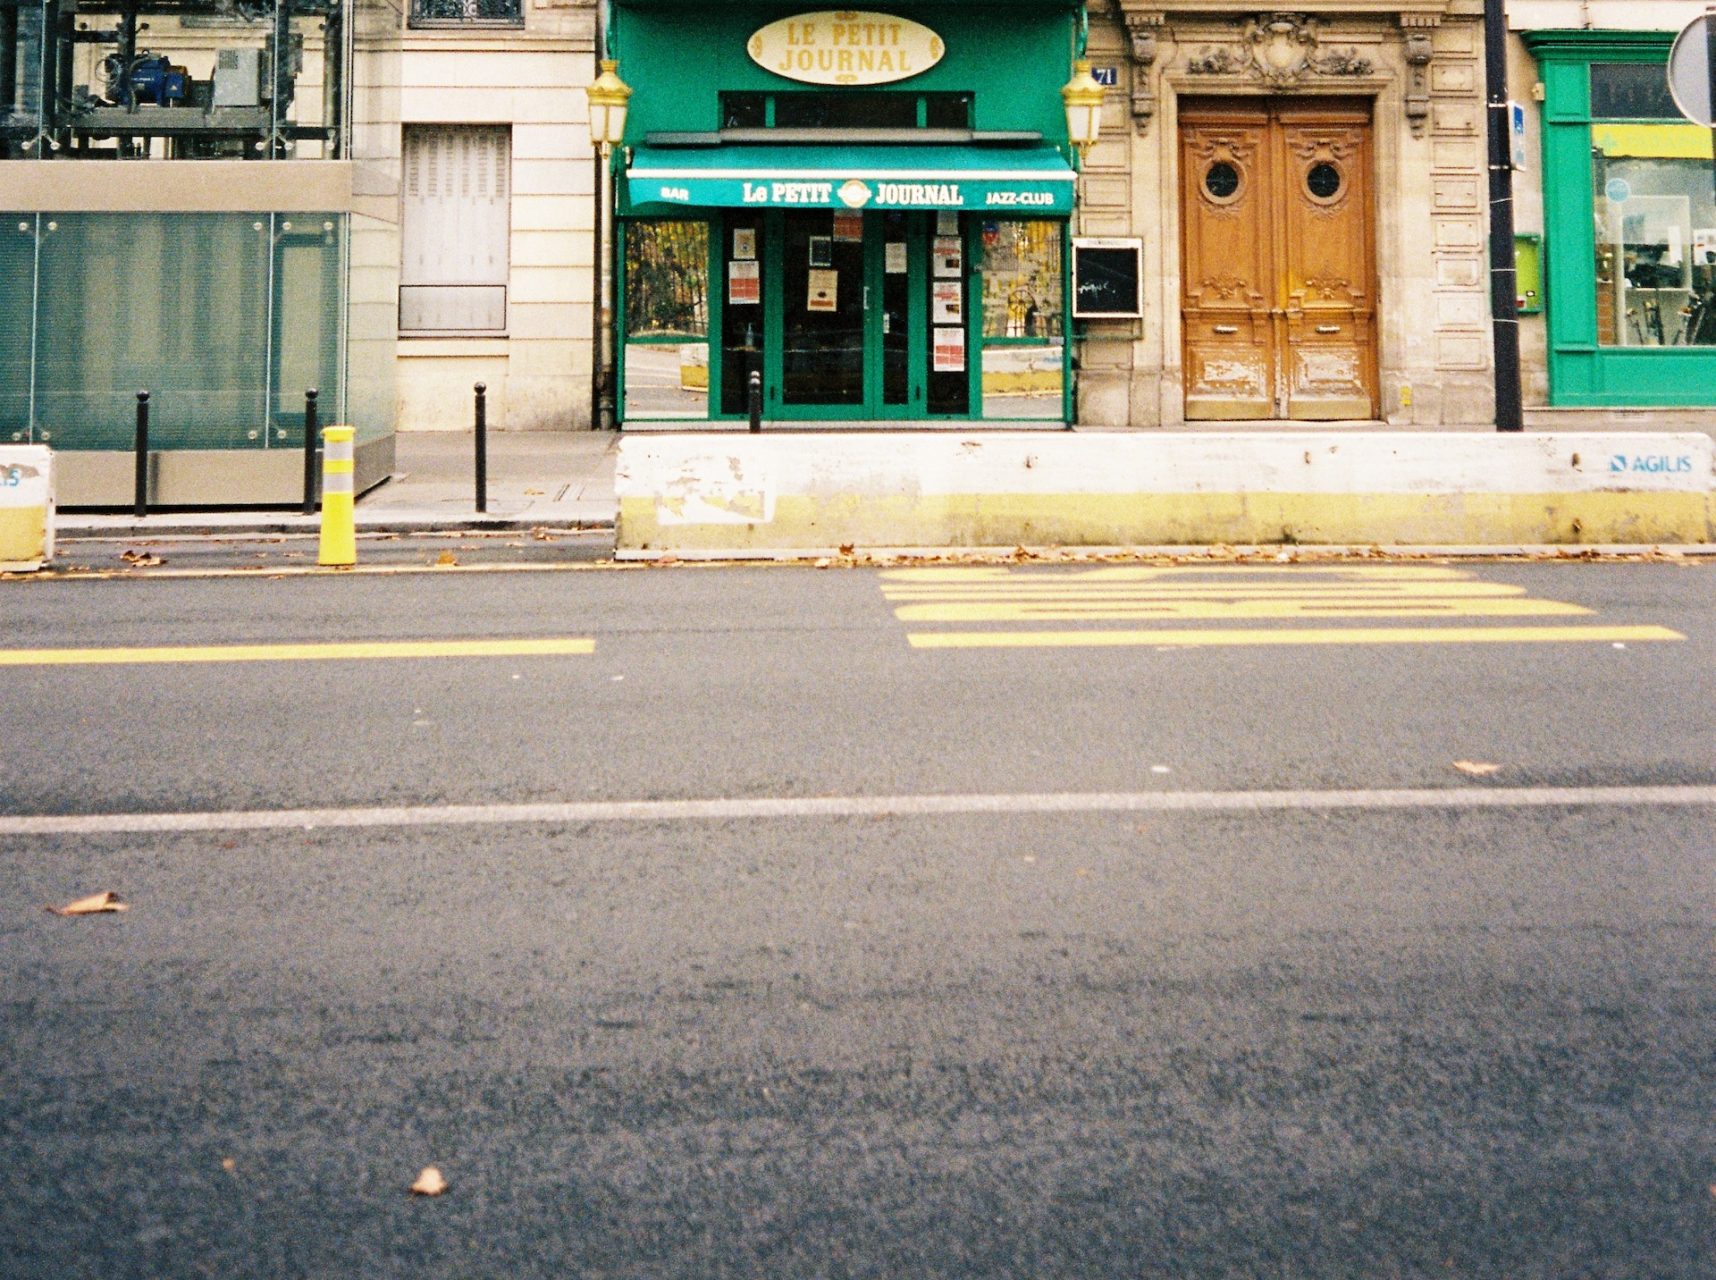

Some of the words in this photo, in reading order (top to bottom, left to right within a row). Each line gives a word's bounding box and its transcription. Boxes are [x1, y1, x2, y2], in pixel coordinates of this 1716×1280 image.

[787, 23, 815, 46] LE
[832, 23, 902, 46] PETIT
[778, 49, 912, 72] JOURNAL
[1096, 68, 1112, 84] 71
[660, 186, 689, 201] BAR
[743, 182, 767, 203] Le
[771, 182, 832, 203] PETIT
[875, 183, 964, 206] JOURNAL
[985, 191, 1055, 206] JAZZ-CLUB
[1631, 454, 1692, 473] AGILIS
